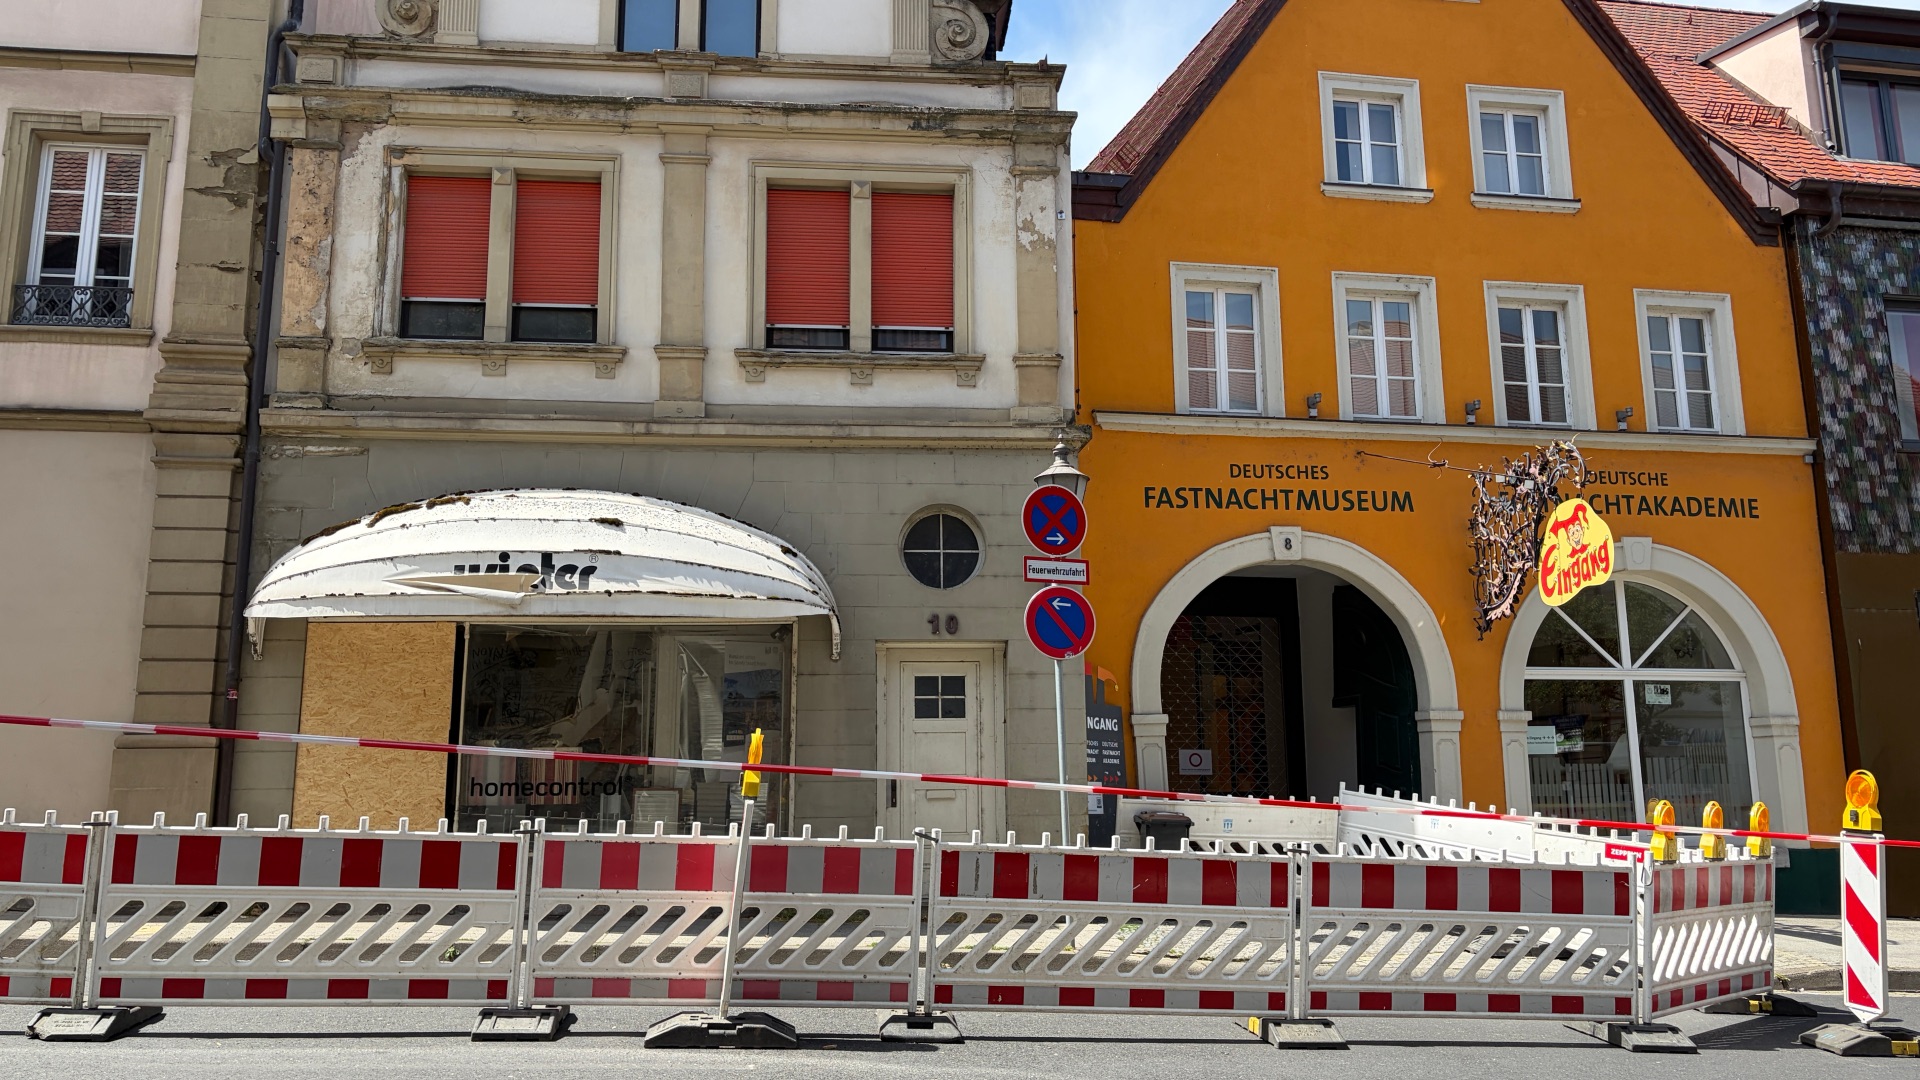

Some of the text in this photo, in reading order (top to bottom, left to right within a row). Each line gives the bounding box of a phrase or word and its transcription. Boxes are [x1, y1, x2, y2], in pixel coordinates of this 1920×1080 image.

[1229, 463, 1330, 481] DEUTSCHES
[1586, 470, 1669, 487] DEUTSCHE
[1144, 486, 1415, 513] FASTNACHTMUSEUM
[1499, 491, 1760, 519] CHTAKADEMIE
[1284, 537, 1293, 550] 8
[1028, 564, 1086, 577] Feuerwehrzufahrt
[1541, 540, 1611, 598] Eingang
[927, 613, 959, 635] 10
[1610, 848, 1643, 859] ZEPPN
